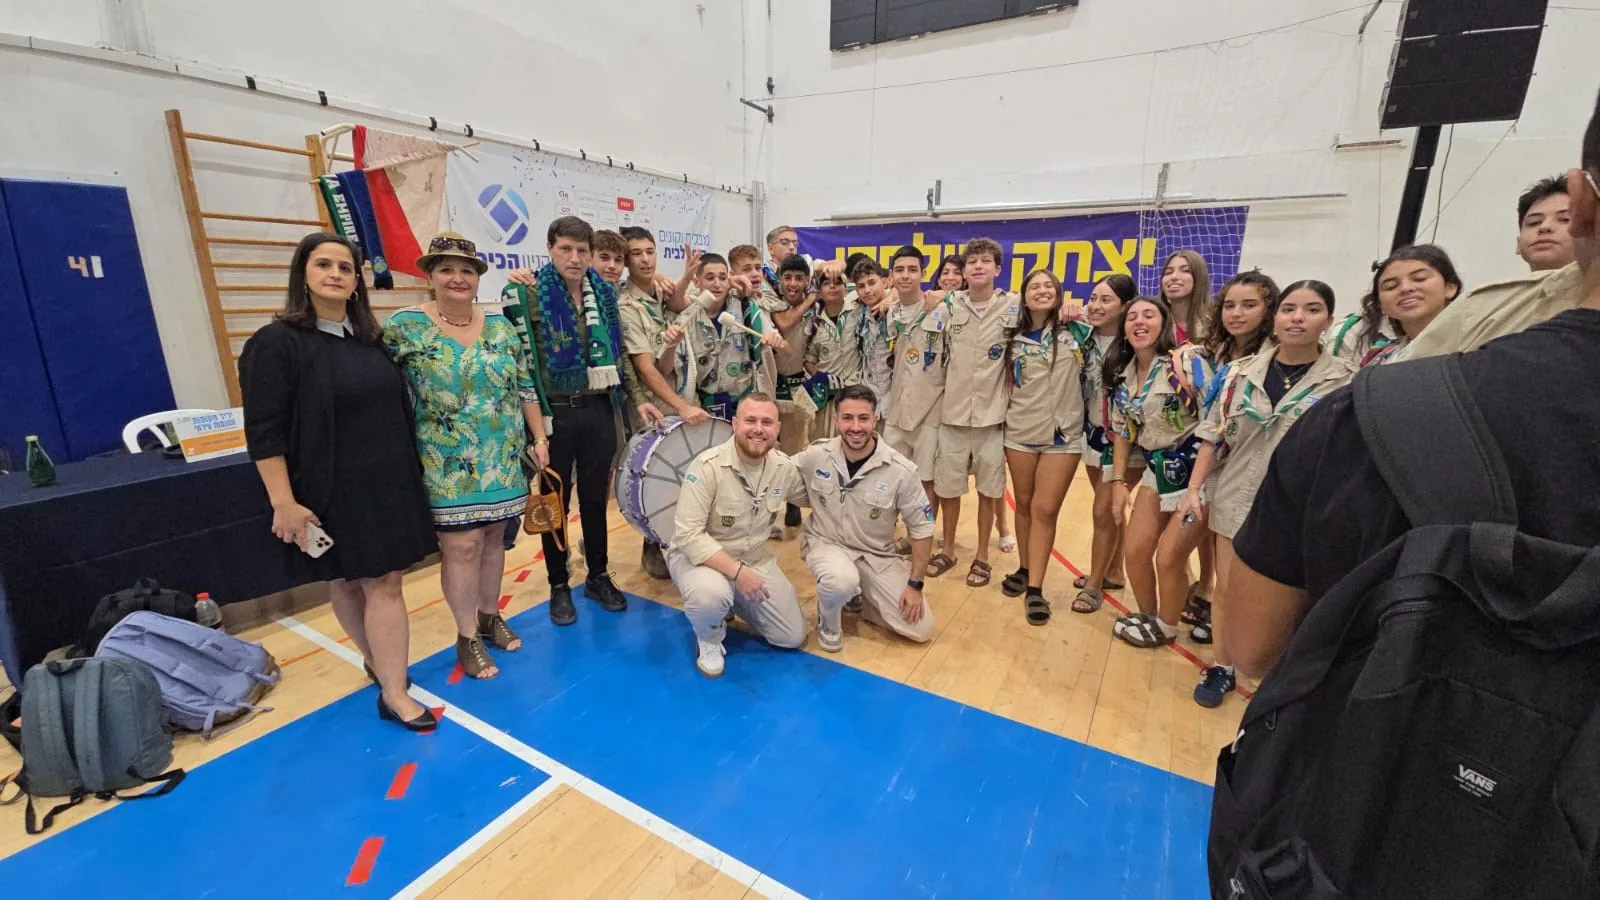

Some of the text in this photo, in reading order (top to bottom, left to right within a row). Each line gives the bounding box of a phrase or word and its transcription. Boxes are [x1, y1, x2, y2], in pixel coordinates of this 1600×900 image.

[332, 193, 360, 242] EMPIRE
[663, 245, 686, 260] לבית
[1010, 238, 1157, 293] יצחק
[1459, 763, 1497, 791] VANS
